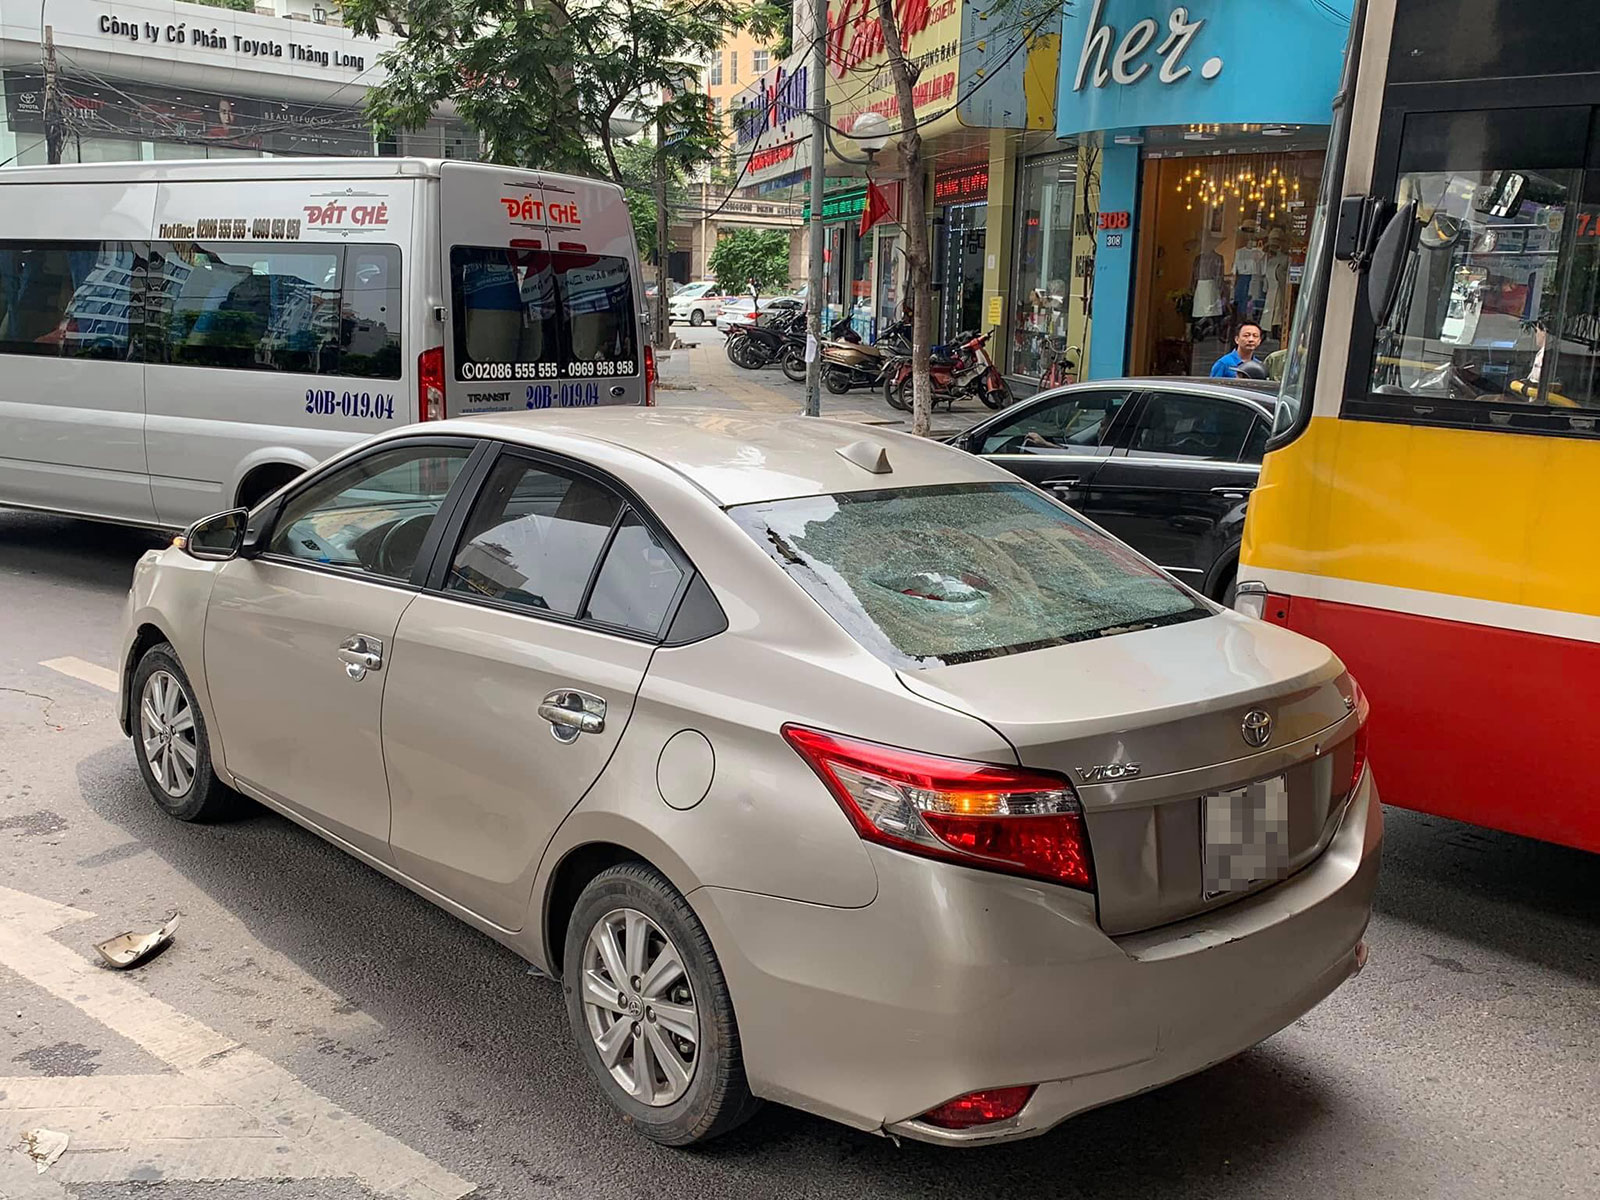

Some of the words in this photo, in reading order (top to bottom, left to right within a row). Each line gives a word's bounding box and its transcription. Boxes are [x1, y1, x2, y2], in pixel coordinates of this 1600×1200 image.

[99, 15, 139, 41] Công
[144, 22, 159, 43] ty
[166, 23, 186, 43] Cổ
[233, 35, 283, 57] Toyota
[288, 43, 329, 67] Thăng
[334, 51, 365, 71] Long
[1072, 0, 1224, 92] her.
[303, 199, 347, 226] ĐẤT
[351, 201, 389, 226] CHÈ
[501, 193, 544, 221] ĐẤT
[548, 200, 581, 224] CHÈ
[158, 222, 195, 239] Hotline:
[1098, 211, 1129, 230] 308
[1106, 235, 1121, 247] 308
[475, 362, 512, 379] 02086
[514, 362, 536, 378] 555
[538, 362, 558, 378] 555
[568, 361, 595, 377] 0969
[596, 361, 615, 376] 958
[616, 360, 634, 375] 958
[305, 389, 394, 420] 20B-019.04
[466, 391, 512, 403] TRANSIT
[1074, 761, 1141, 781] VIOS
